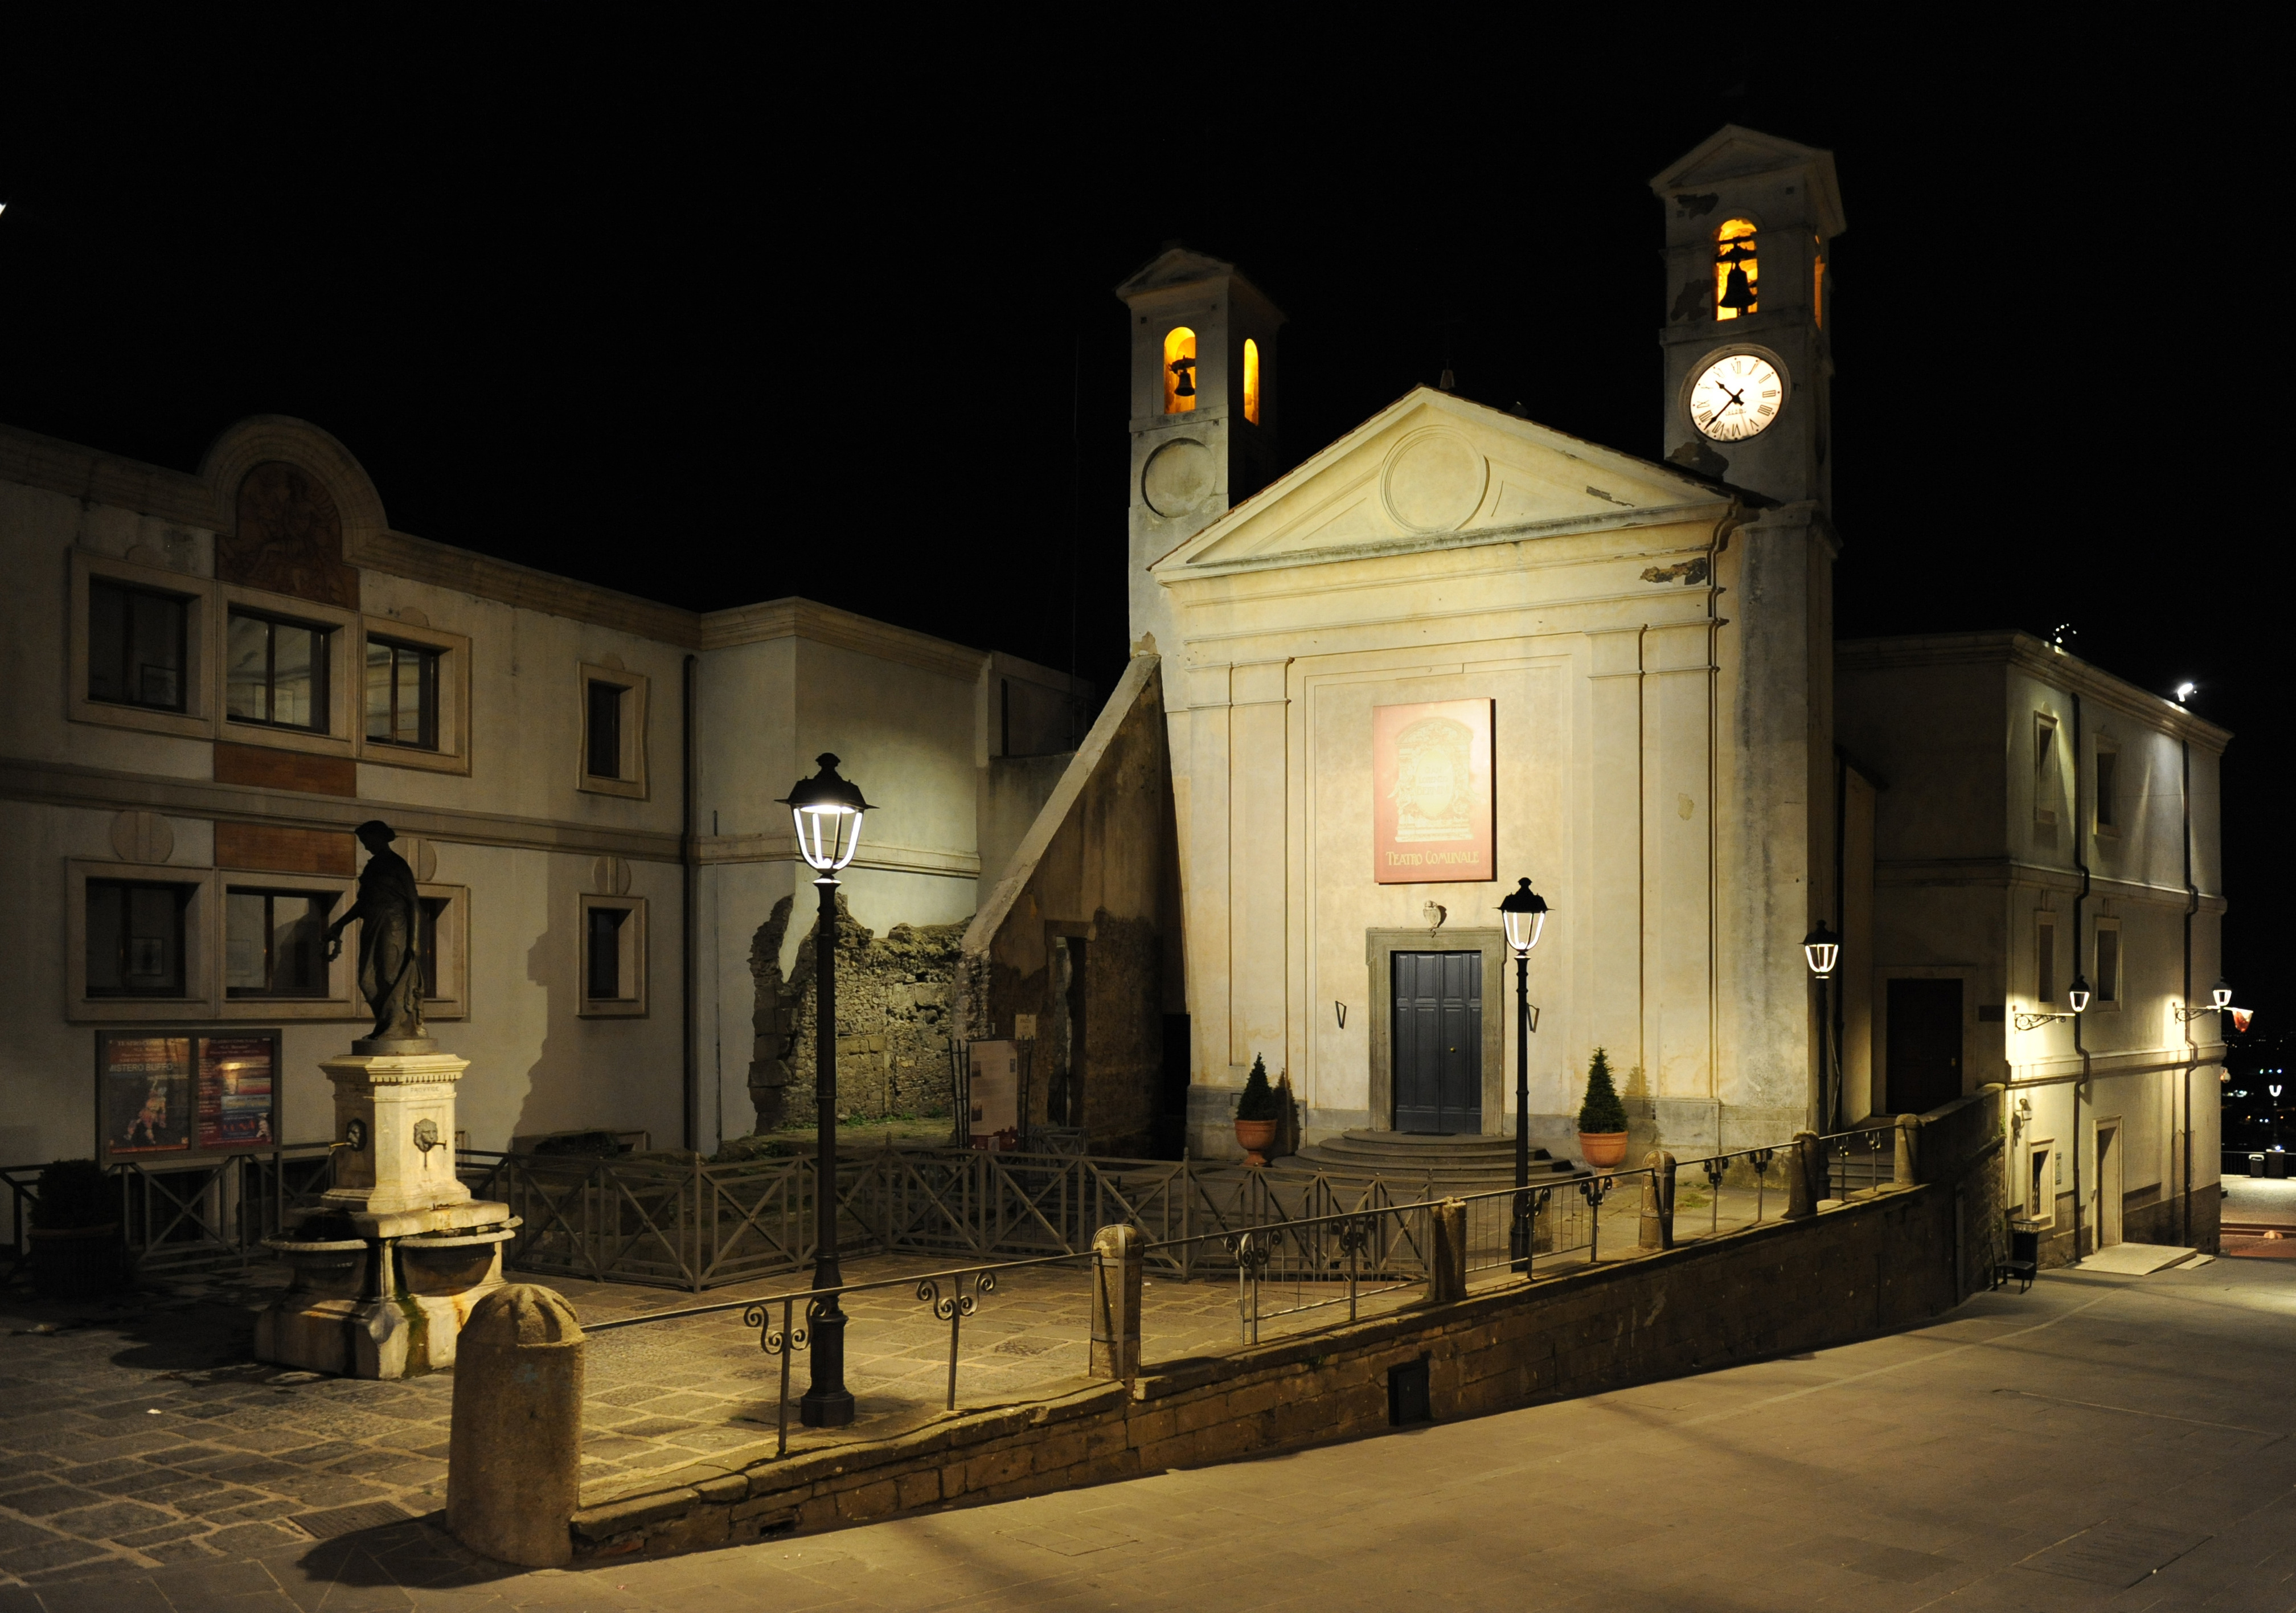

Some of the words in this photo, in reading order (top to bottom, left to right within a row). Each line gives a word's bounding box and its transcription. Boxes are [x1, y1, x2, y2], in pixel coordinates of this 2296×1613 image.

[1385, 851, 1423, 866] TEATRO
[1425, 850, 1479, 865] COMUNALE
[146, 1063, 174, 1071] BUFFO
